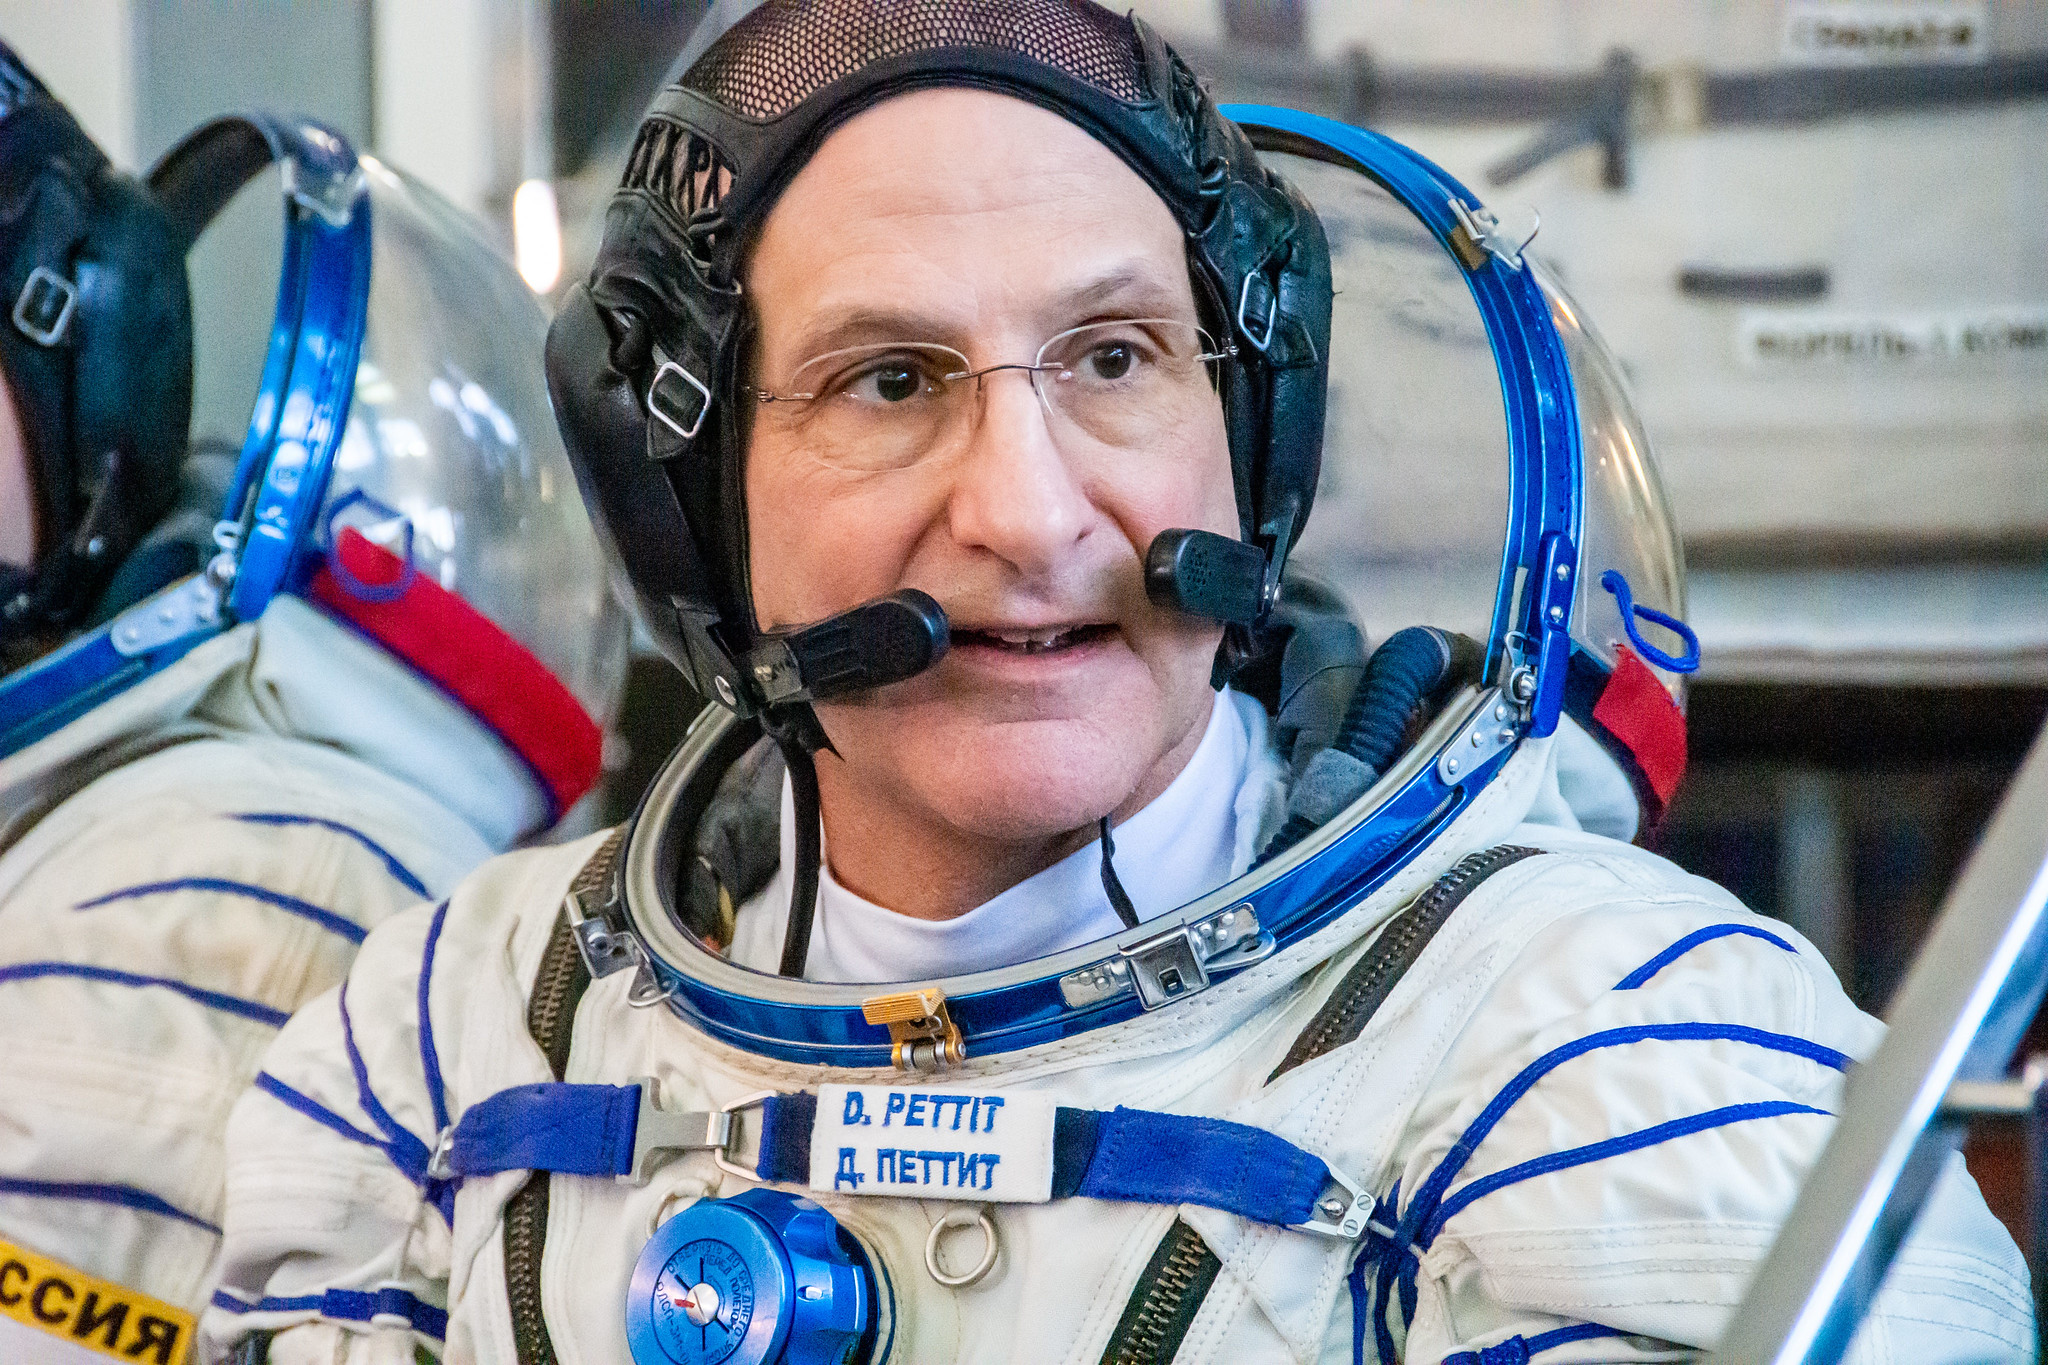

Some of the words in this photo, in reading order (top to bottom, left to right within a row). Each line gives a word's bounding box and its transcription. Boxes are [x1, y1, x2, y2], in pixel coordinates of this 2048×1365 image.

[843, 1091, 871, 1126] D.
[882, 1092, 1005, 1134] PETTIT
[834, 1147, 865, 1191] Д.
[877, 1148, 1000, 1191] ПЕТТИТ
[704, 1255, 732, 1276] ПЕРЕД
[727, 1278, 741, 1330] ПОЛЕТОМ
[726, 1252, 741, 1268] ДО
[734, 1270, 751, 1337] СРЕДНЕГО
